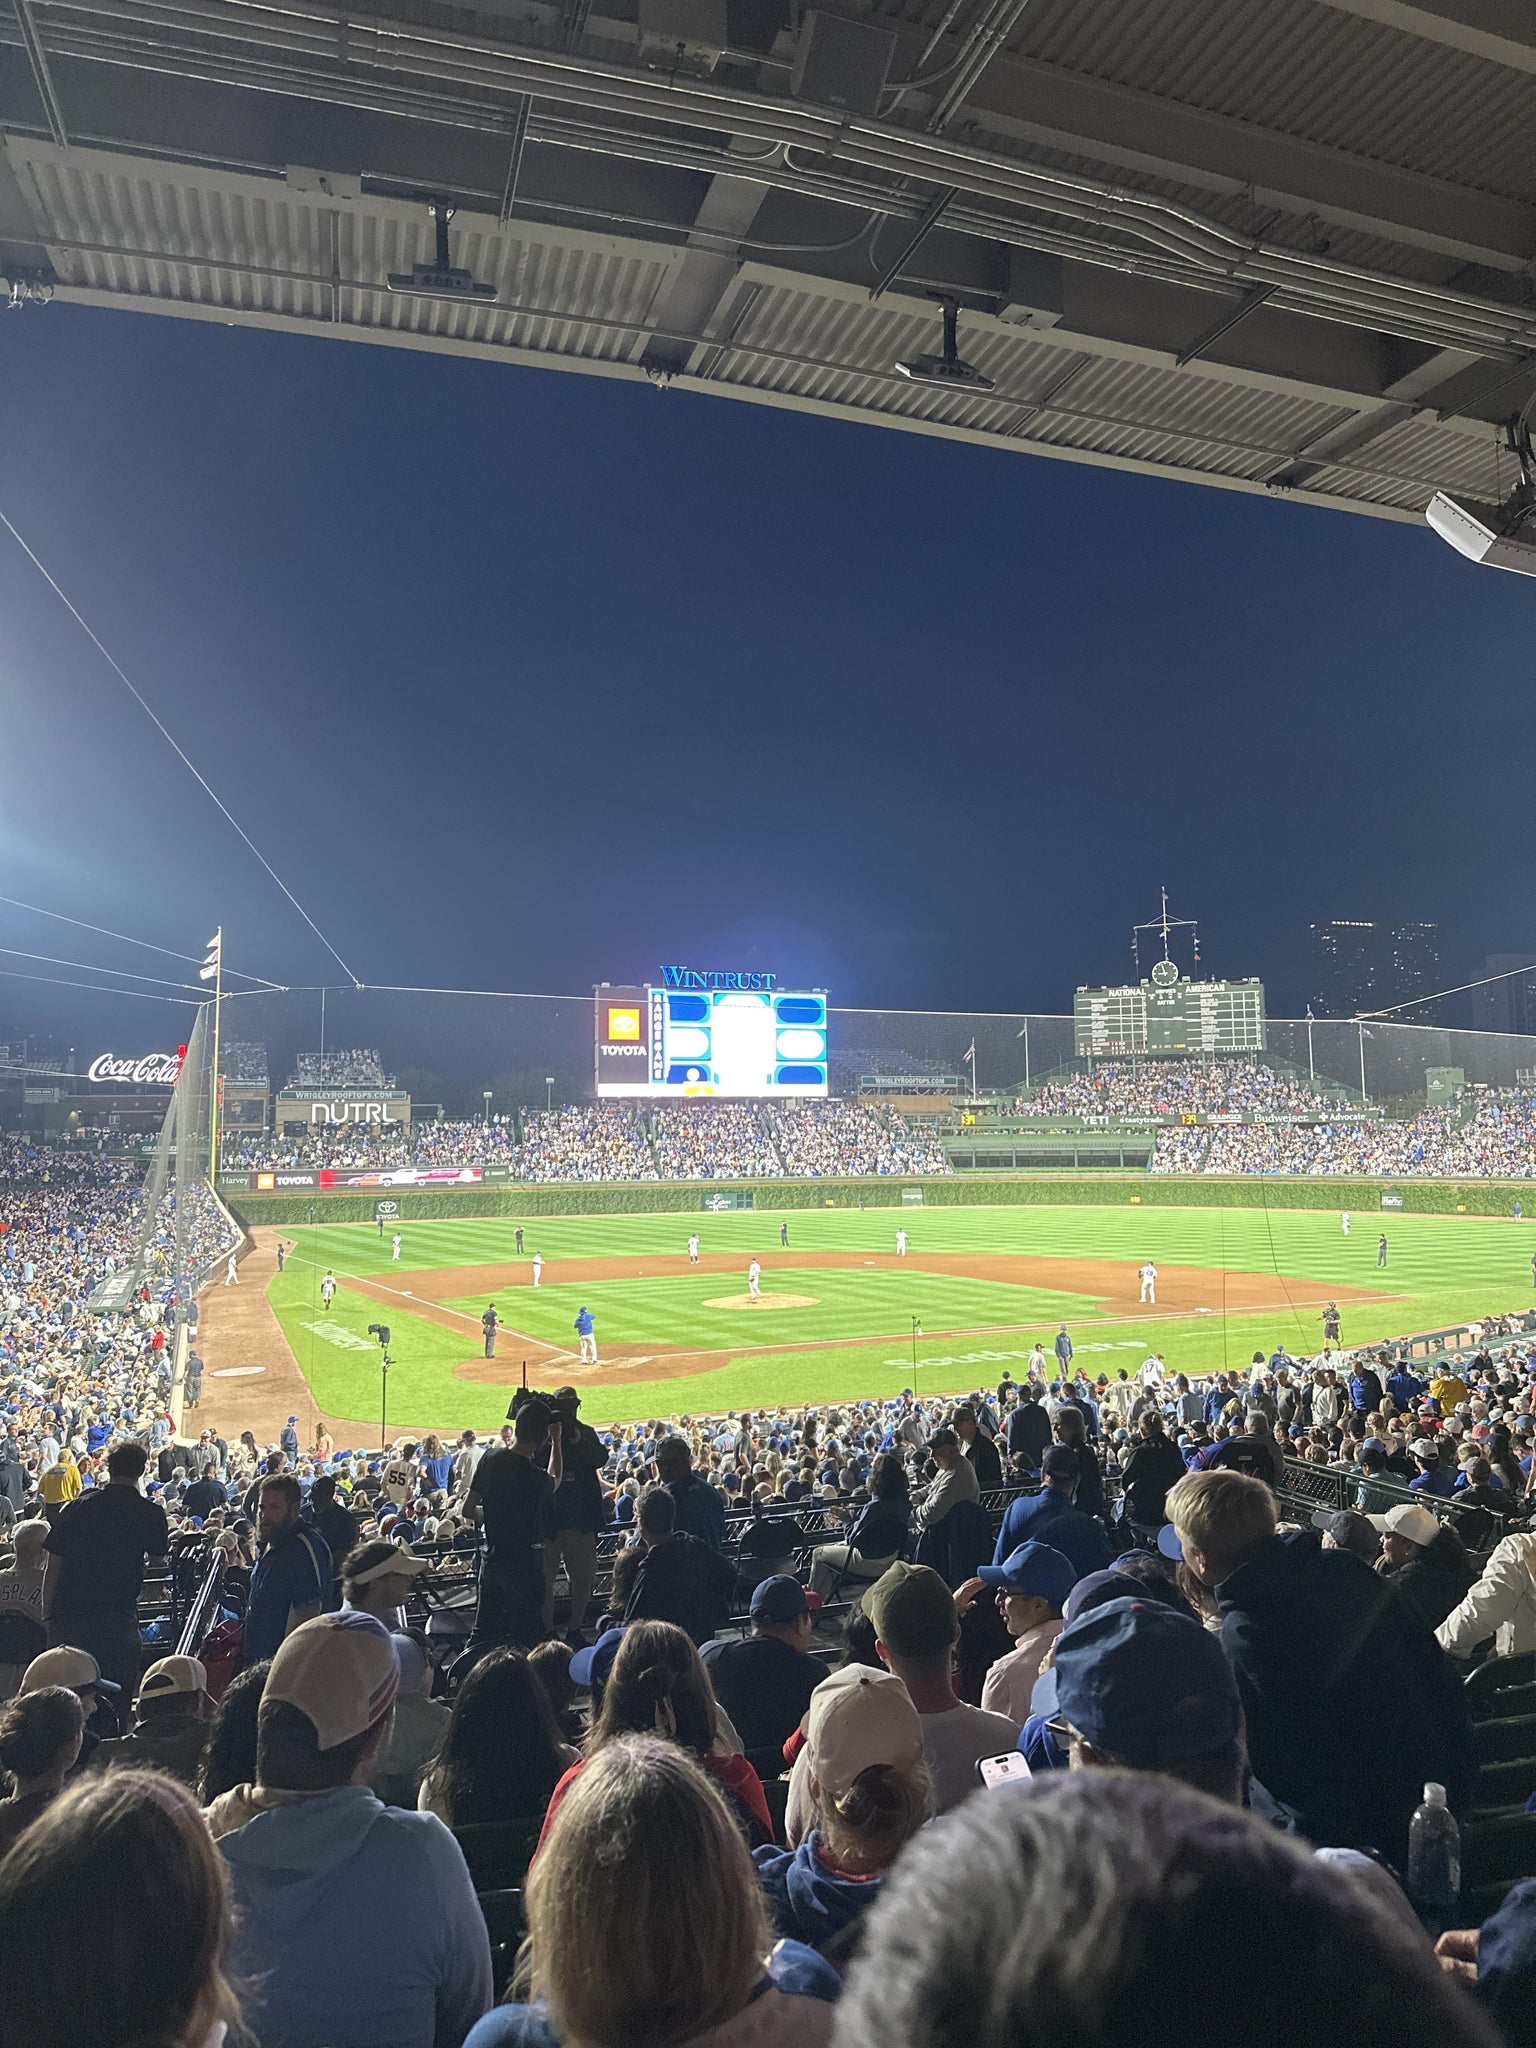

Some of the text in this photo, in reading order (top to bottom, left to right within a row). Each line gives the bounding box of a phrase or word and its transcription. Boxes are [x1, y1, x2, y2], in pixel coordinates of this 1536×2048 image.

[659, 965, 776, 990] WINTRUST
[1108, 987, 1147, 997] NATIONAL
[1185, 983, 1225, 993] AMERICAN
[601, 1045, 647, 1056] TOYOTA
[1081, 1115, 1109, 1125] YETI
[1125, 1116, 1164, 1124] tastytrade
[1329, 1113, 1367, 1121] Advocate
[222, 1176, 249, 1185] Harvey
[276, 1176, 314, 1185] TOYOTA
[388, 1470, 407, 1486] 55
